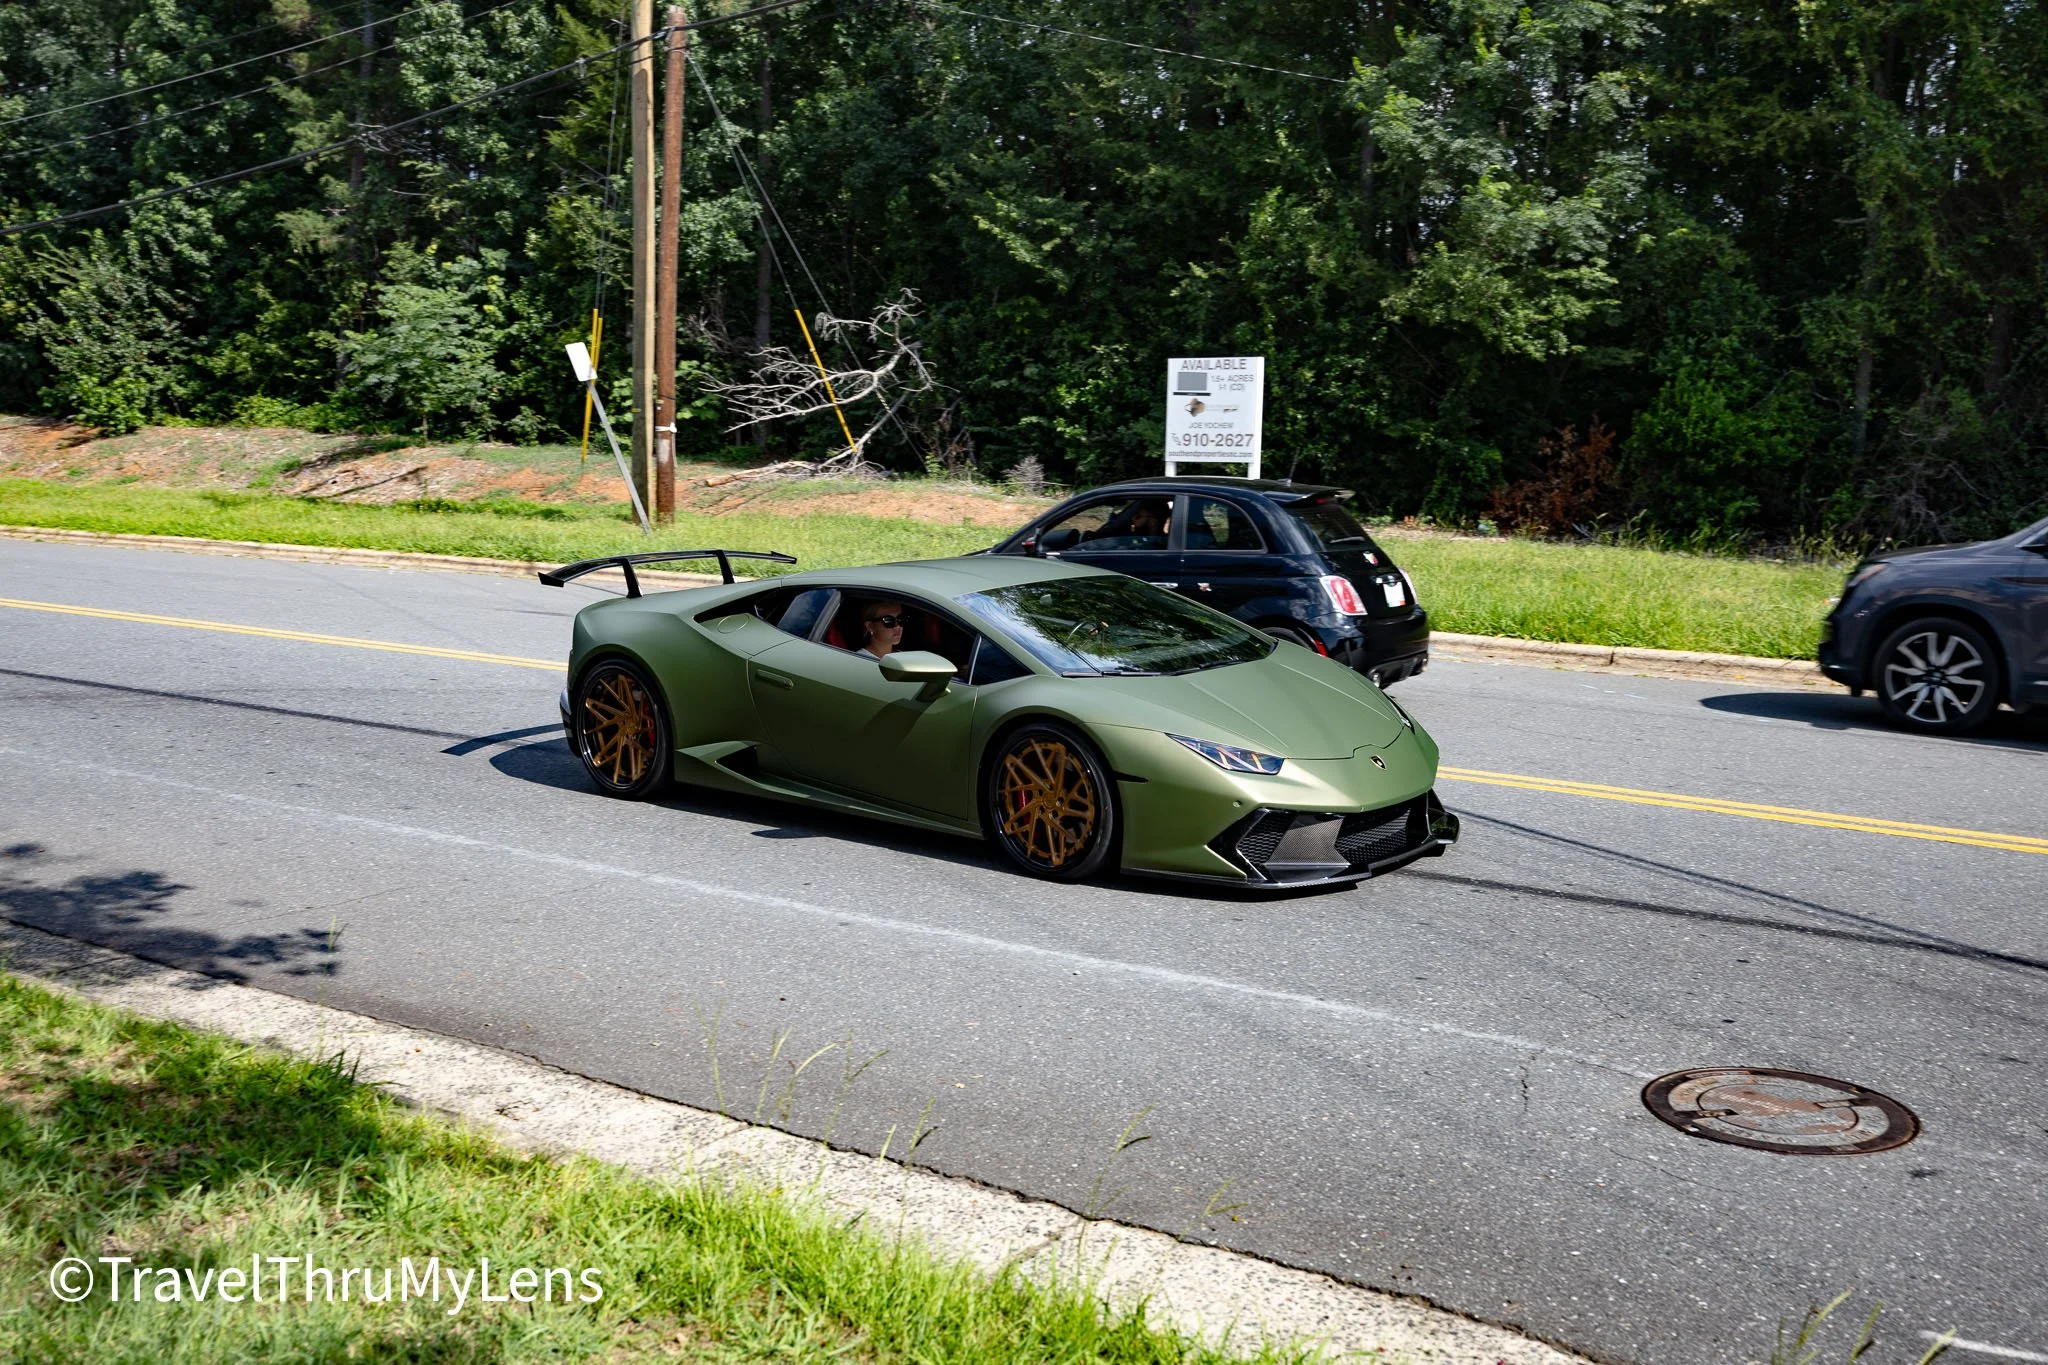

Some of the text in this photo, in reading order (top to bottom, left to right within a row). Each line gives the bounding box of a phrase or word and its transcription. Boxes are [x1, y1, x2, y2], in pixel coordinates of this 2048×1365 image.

[1181, 359, 1247, 370] AVAILABLE
[1227, 374, 1255, 382] ACRES
[1182, 433, 1254, 447] 910-2627
